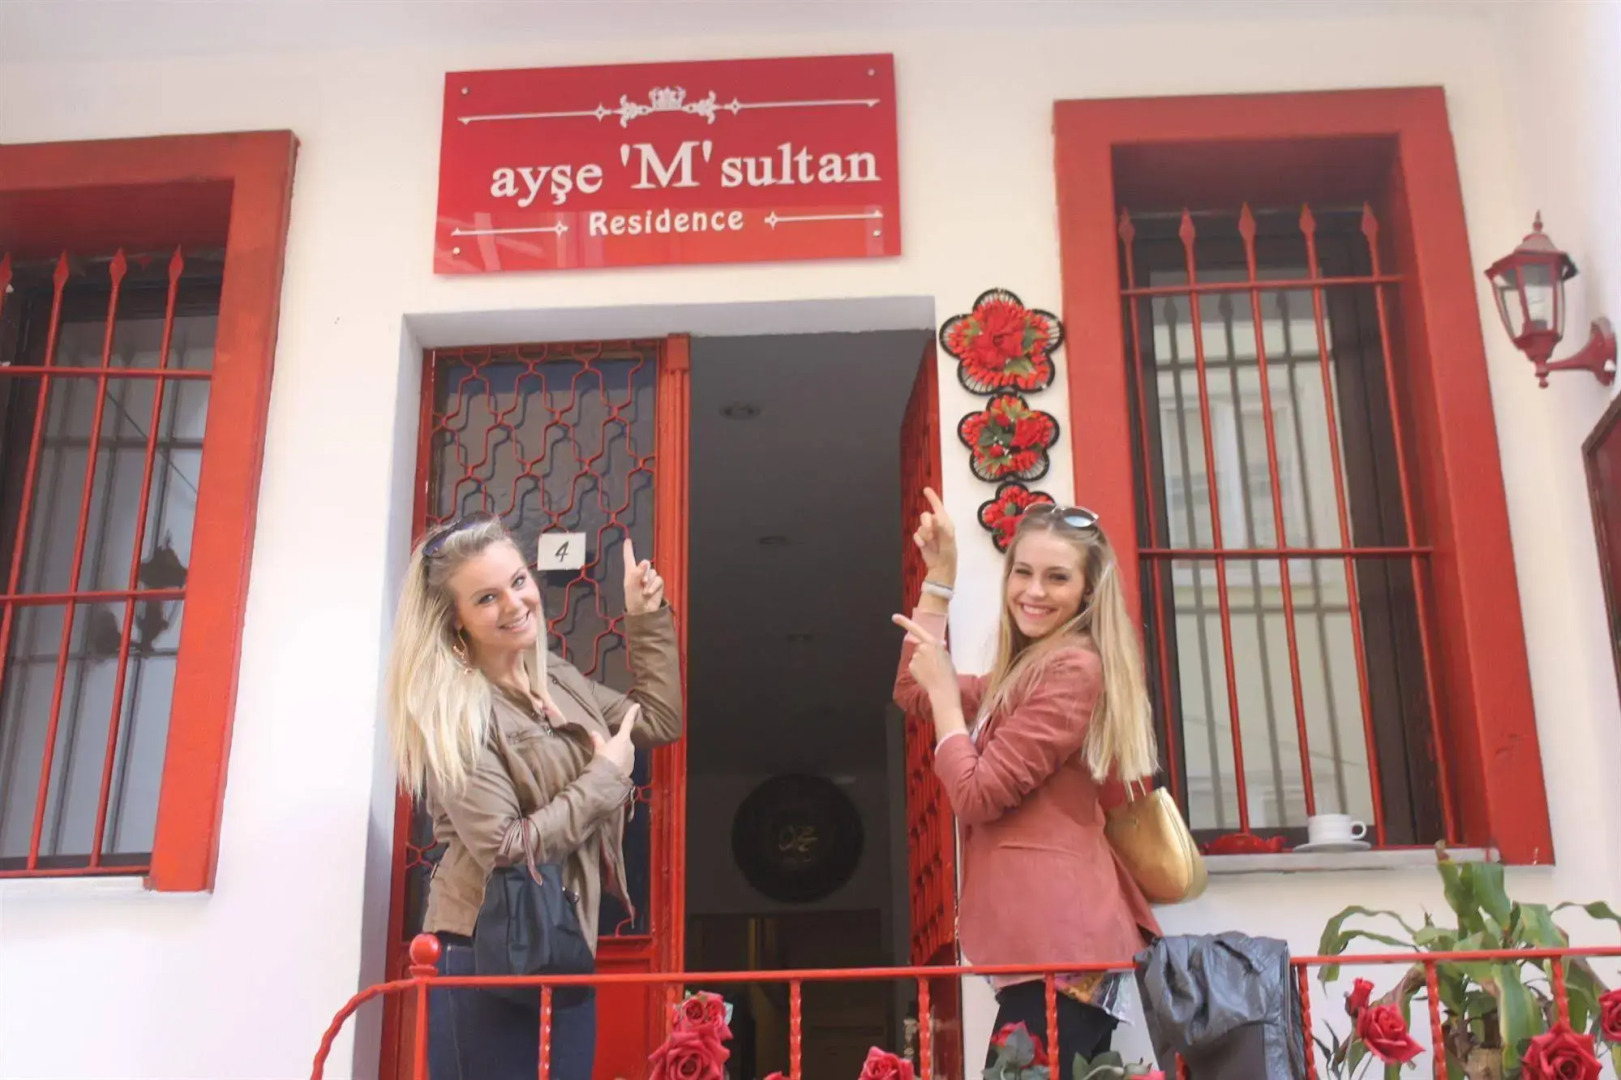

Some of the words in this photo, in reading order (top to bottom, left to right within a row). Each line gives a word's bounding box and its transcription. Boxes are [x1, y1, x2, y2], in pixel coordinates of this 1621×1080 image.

[490, 163, 603, 208] ayşe
[589, 208, 744, 237] Residence
[554, 540, 570, 563] 4
